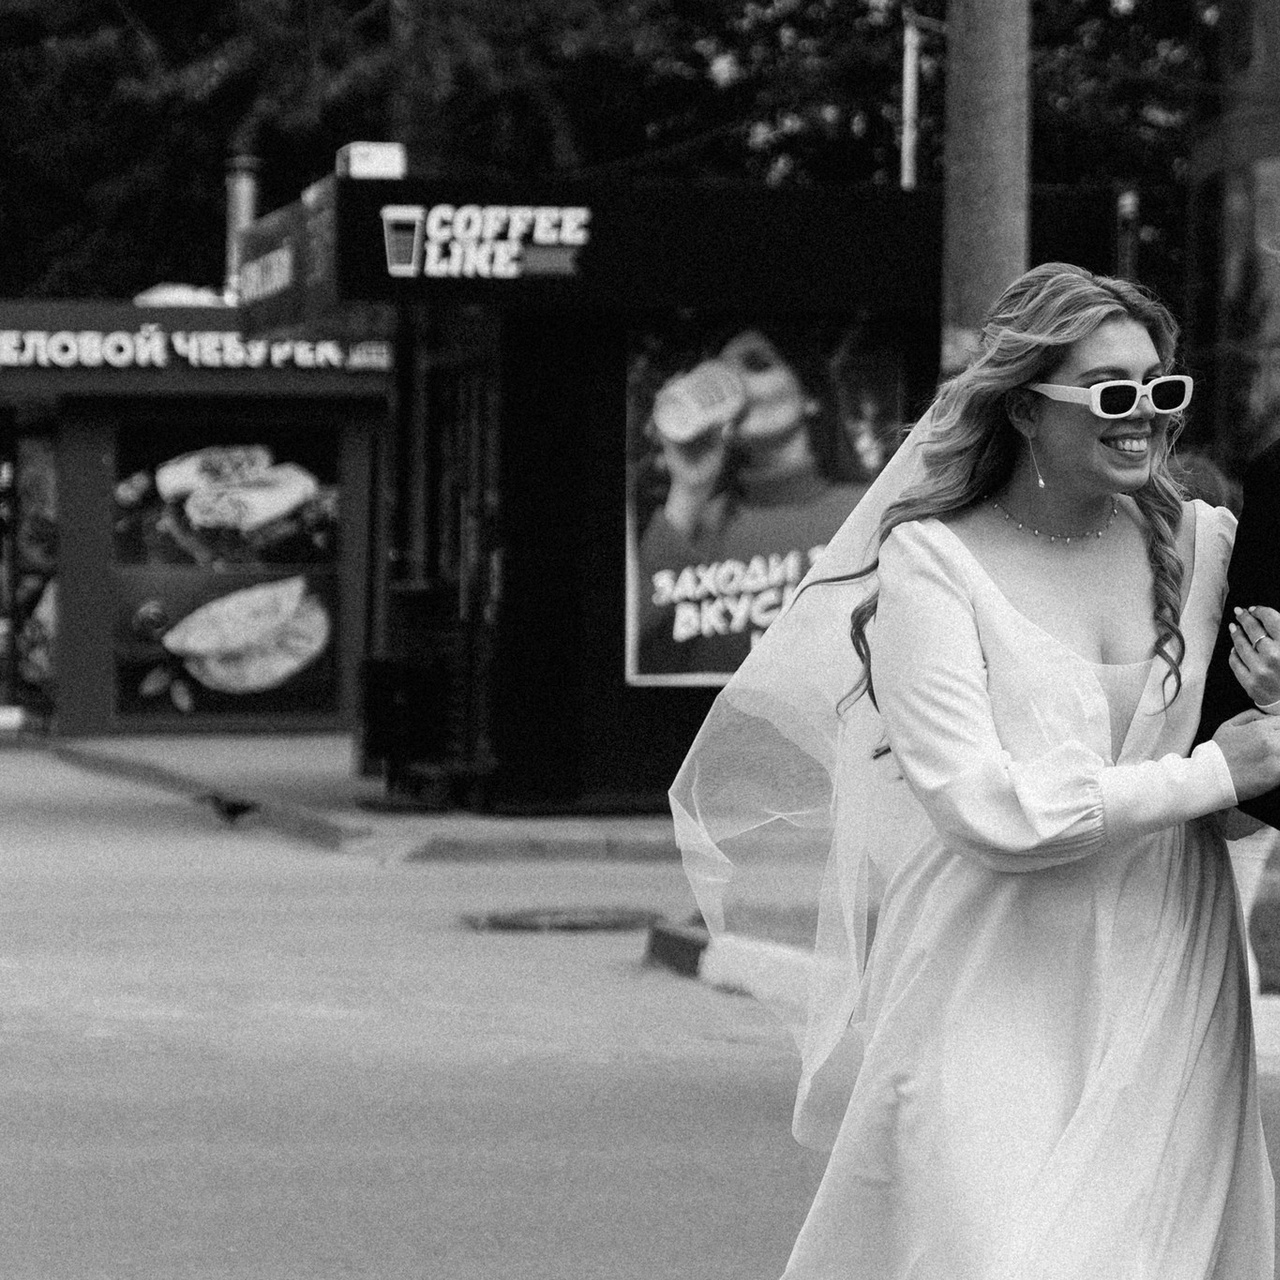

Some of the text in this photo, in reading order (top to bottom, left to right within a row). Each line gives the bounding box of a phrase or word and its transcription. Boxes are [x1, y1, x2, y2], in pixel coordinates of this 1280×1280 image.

[426, 203, 590, 246] COFFEE
[424, 239, 522, 278] LIKE
[652, 550, 801, 606] ЗАХОДИ
